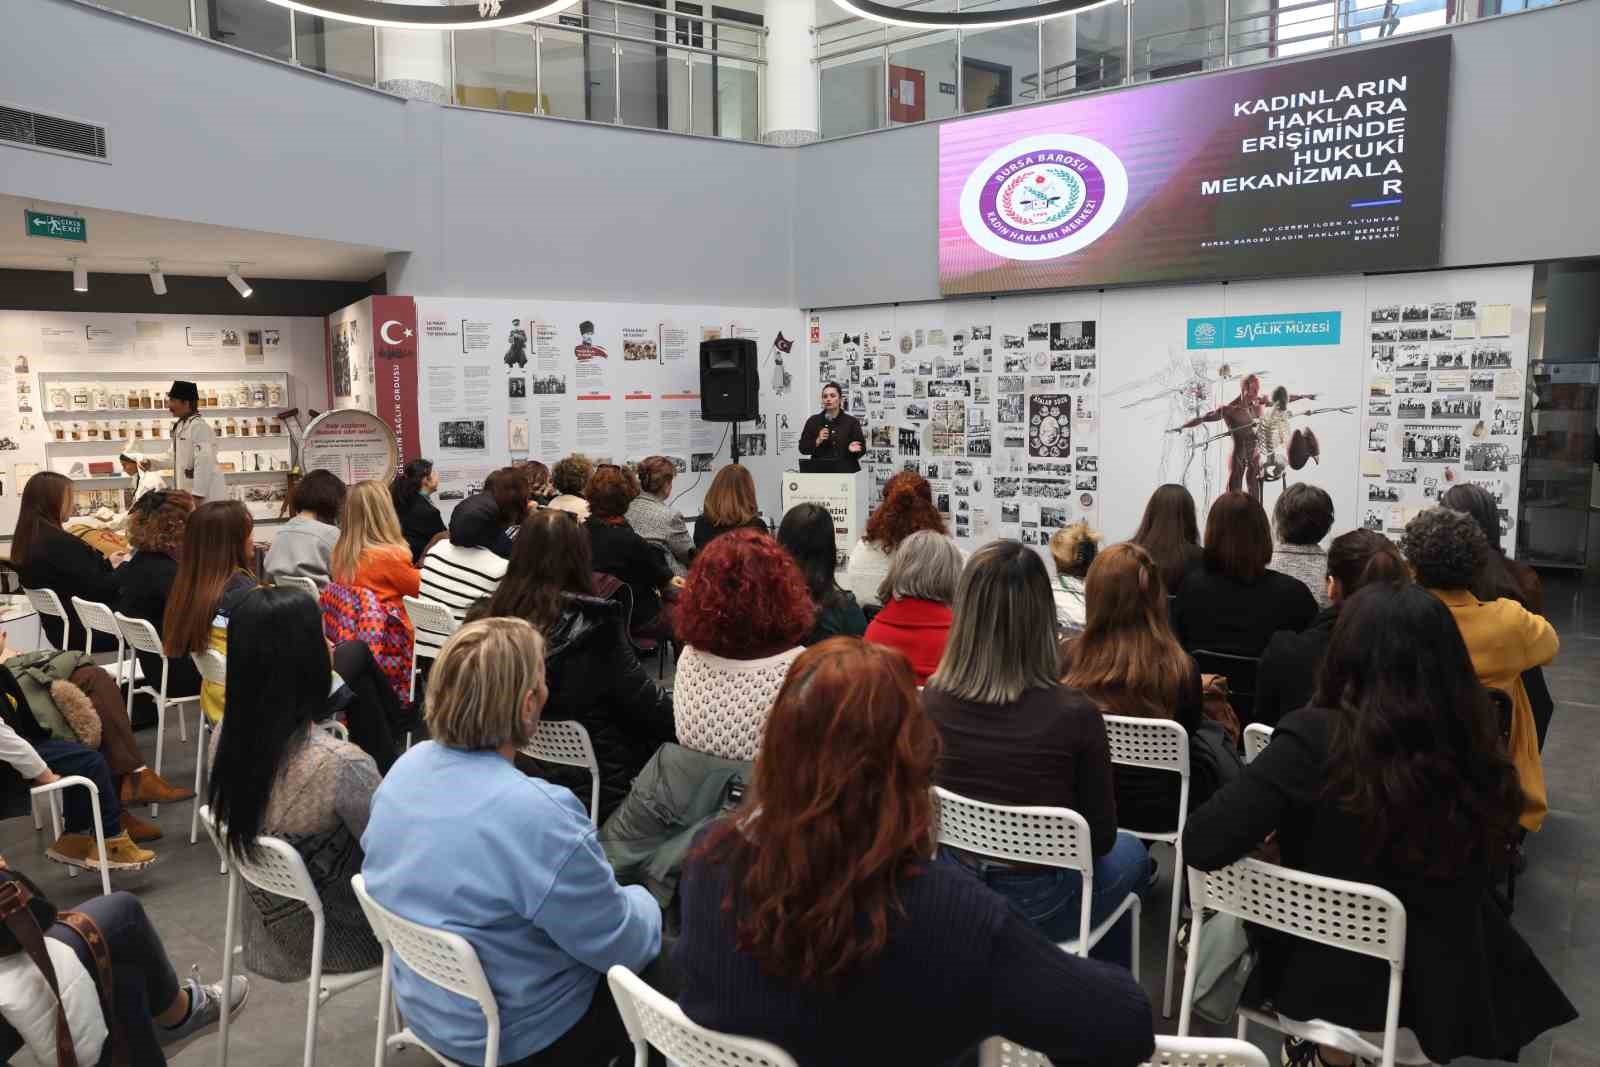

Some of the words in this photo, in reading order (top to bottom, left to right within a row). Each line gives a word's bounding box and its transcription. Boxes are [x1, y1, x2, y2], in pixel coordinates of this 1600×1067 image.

[1233, 75, 1407, 117] KADINLARIN
[1268, 97, 1407, 131] HAKLARA
[1242, 117, 1406, 153] ERİŞİMİNDE
[1293, 134, 1404, 166] HUKUKİ
[996, 157, 1034, 182] BURSA
[1037, 153, 1089, 172] BAROSU
[1201, 158, 1403, 196] MEKANİZMALA
[1382, 179, 1403, 196] R
[62, 225, 81, 233] EXIT
[1010, 232, 1060, 243] HAKLARI
[1061, 199, 1098, 235] MERKEZİ
[1235, 322, 1282, 341] SAĞLIK
[1286, 319, 1331, 334] MÜZESİ
[392, 364, 401, 401] ORDUSU
